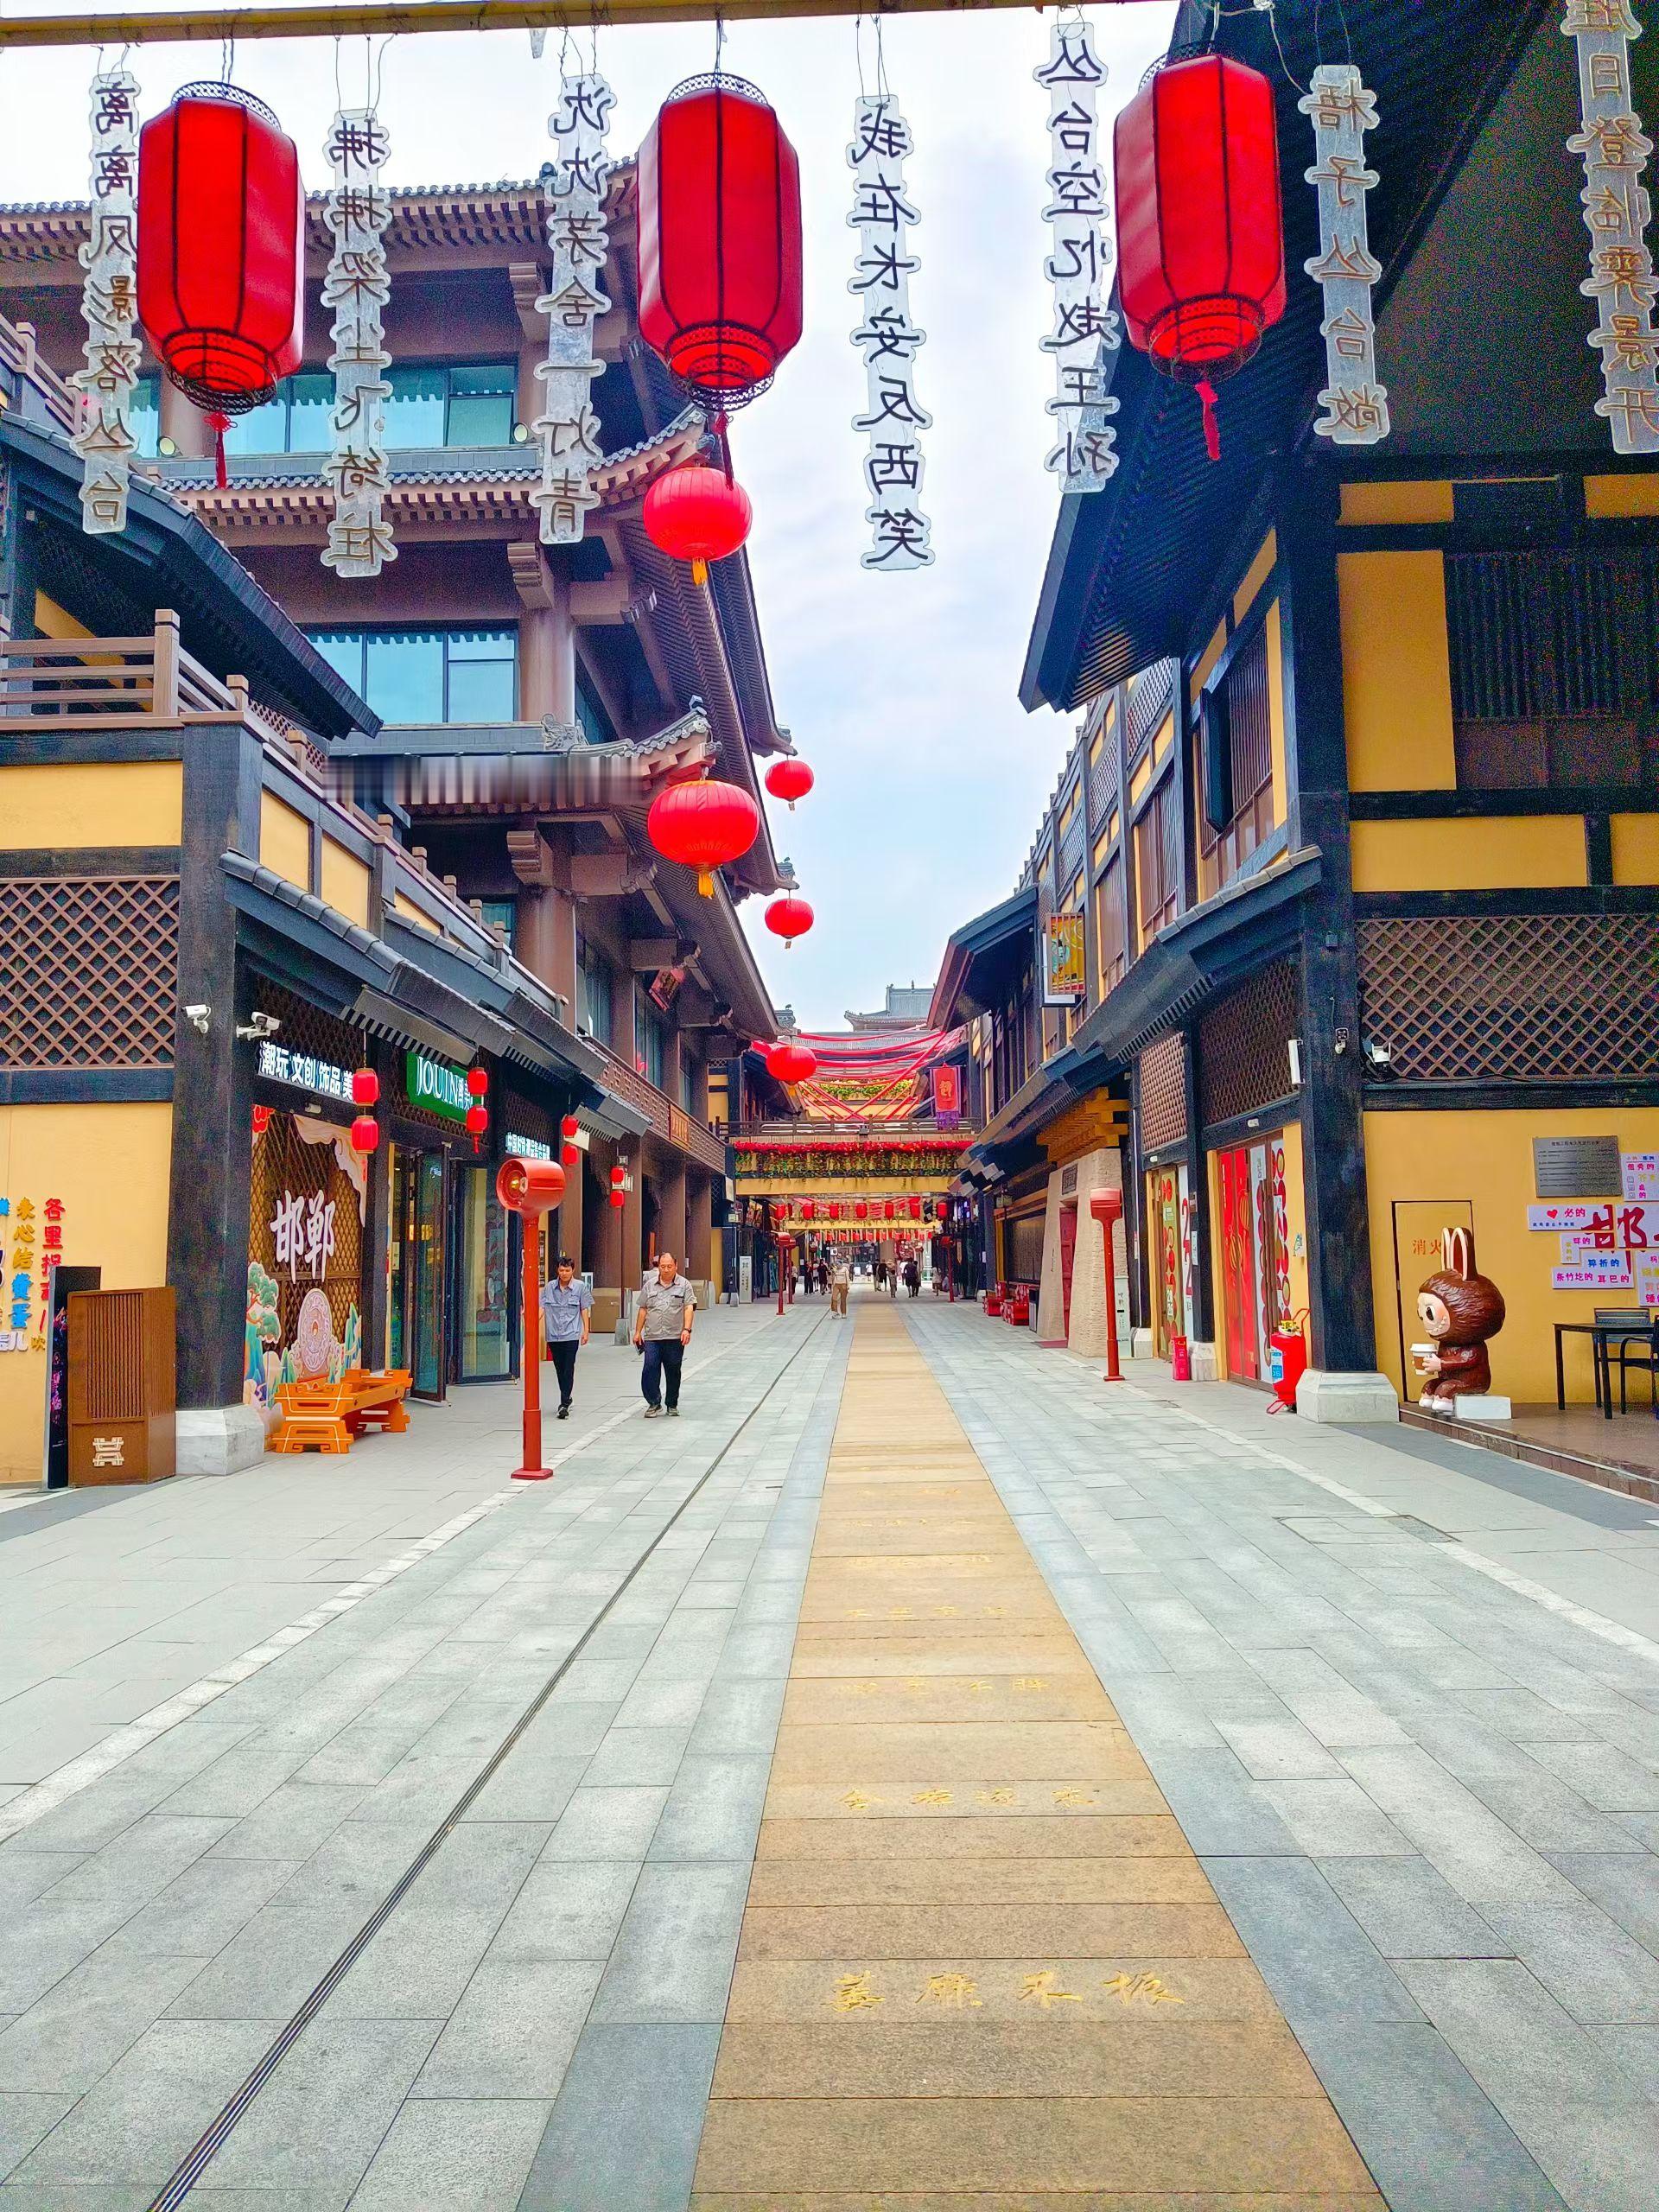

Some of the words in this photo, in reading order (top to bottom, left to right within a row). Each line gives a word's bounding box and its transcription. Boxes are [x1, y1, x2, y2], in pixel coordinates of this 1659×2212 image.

[416, 1056, 459, 1109] JOUIN
[270, 1190, 335, 1284] 邯郸
[1413, 1239, 1441, 1255] 消火
